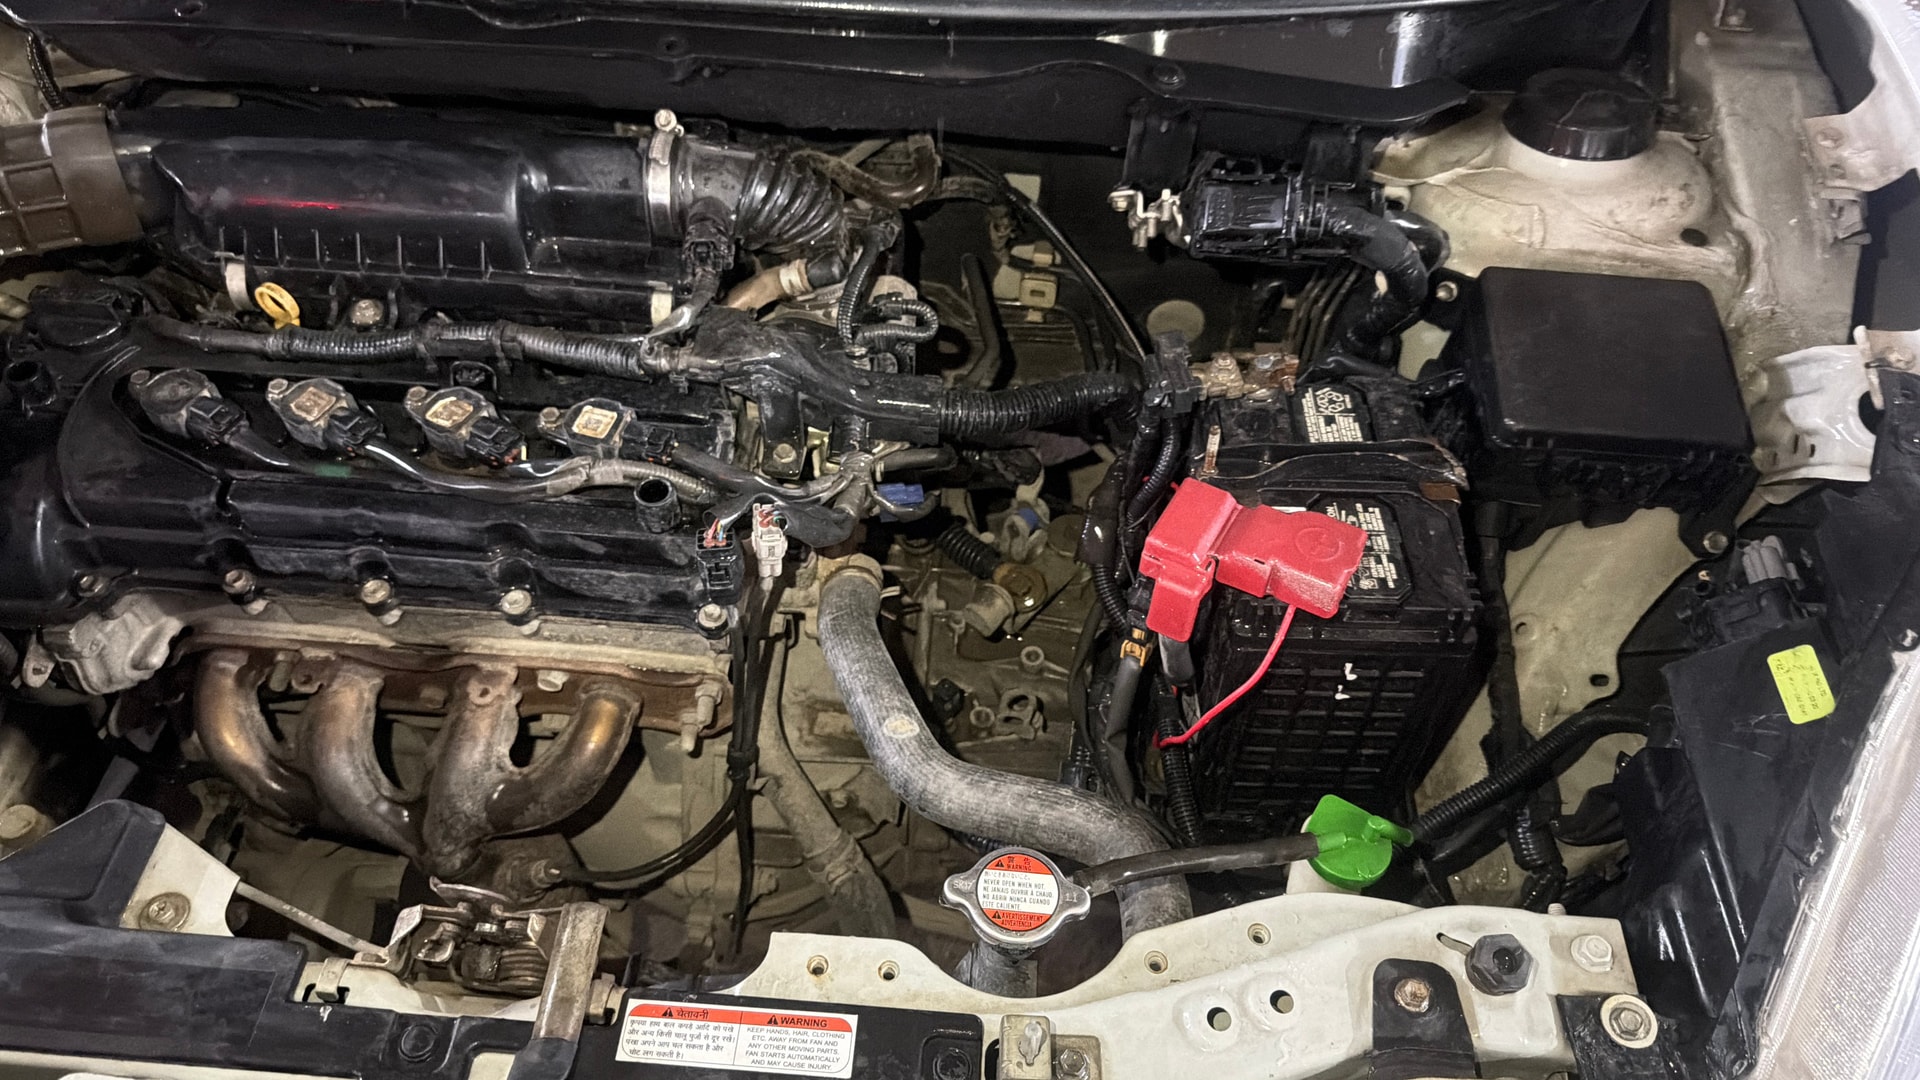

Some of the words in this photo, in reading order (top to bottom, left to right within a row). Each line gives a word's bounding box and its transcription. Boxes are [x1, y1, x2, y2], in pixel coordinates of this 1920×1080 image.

[1002, 913, 1043, 921] AVERTISSEMENT
[677, 1008, 708, 1020] चेतावनी
[781, 1017, 827, 1027] WARNING
[656, 1029, 672, 1038] किसी
[706, 1043, 710, 1051] है
[787, 1053, 840, 1063] AUTOMATICALLY
